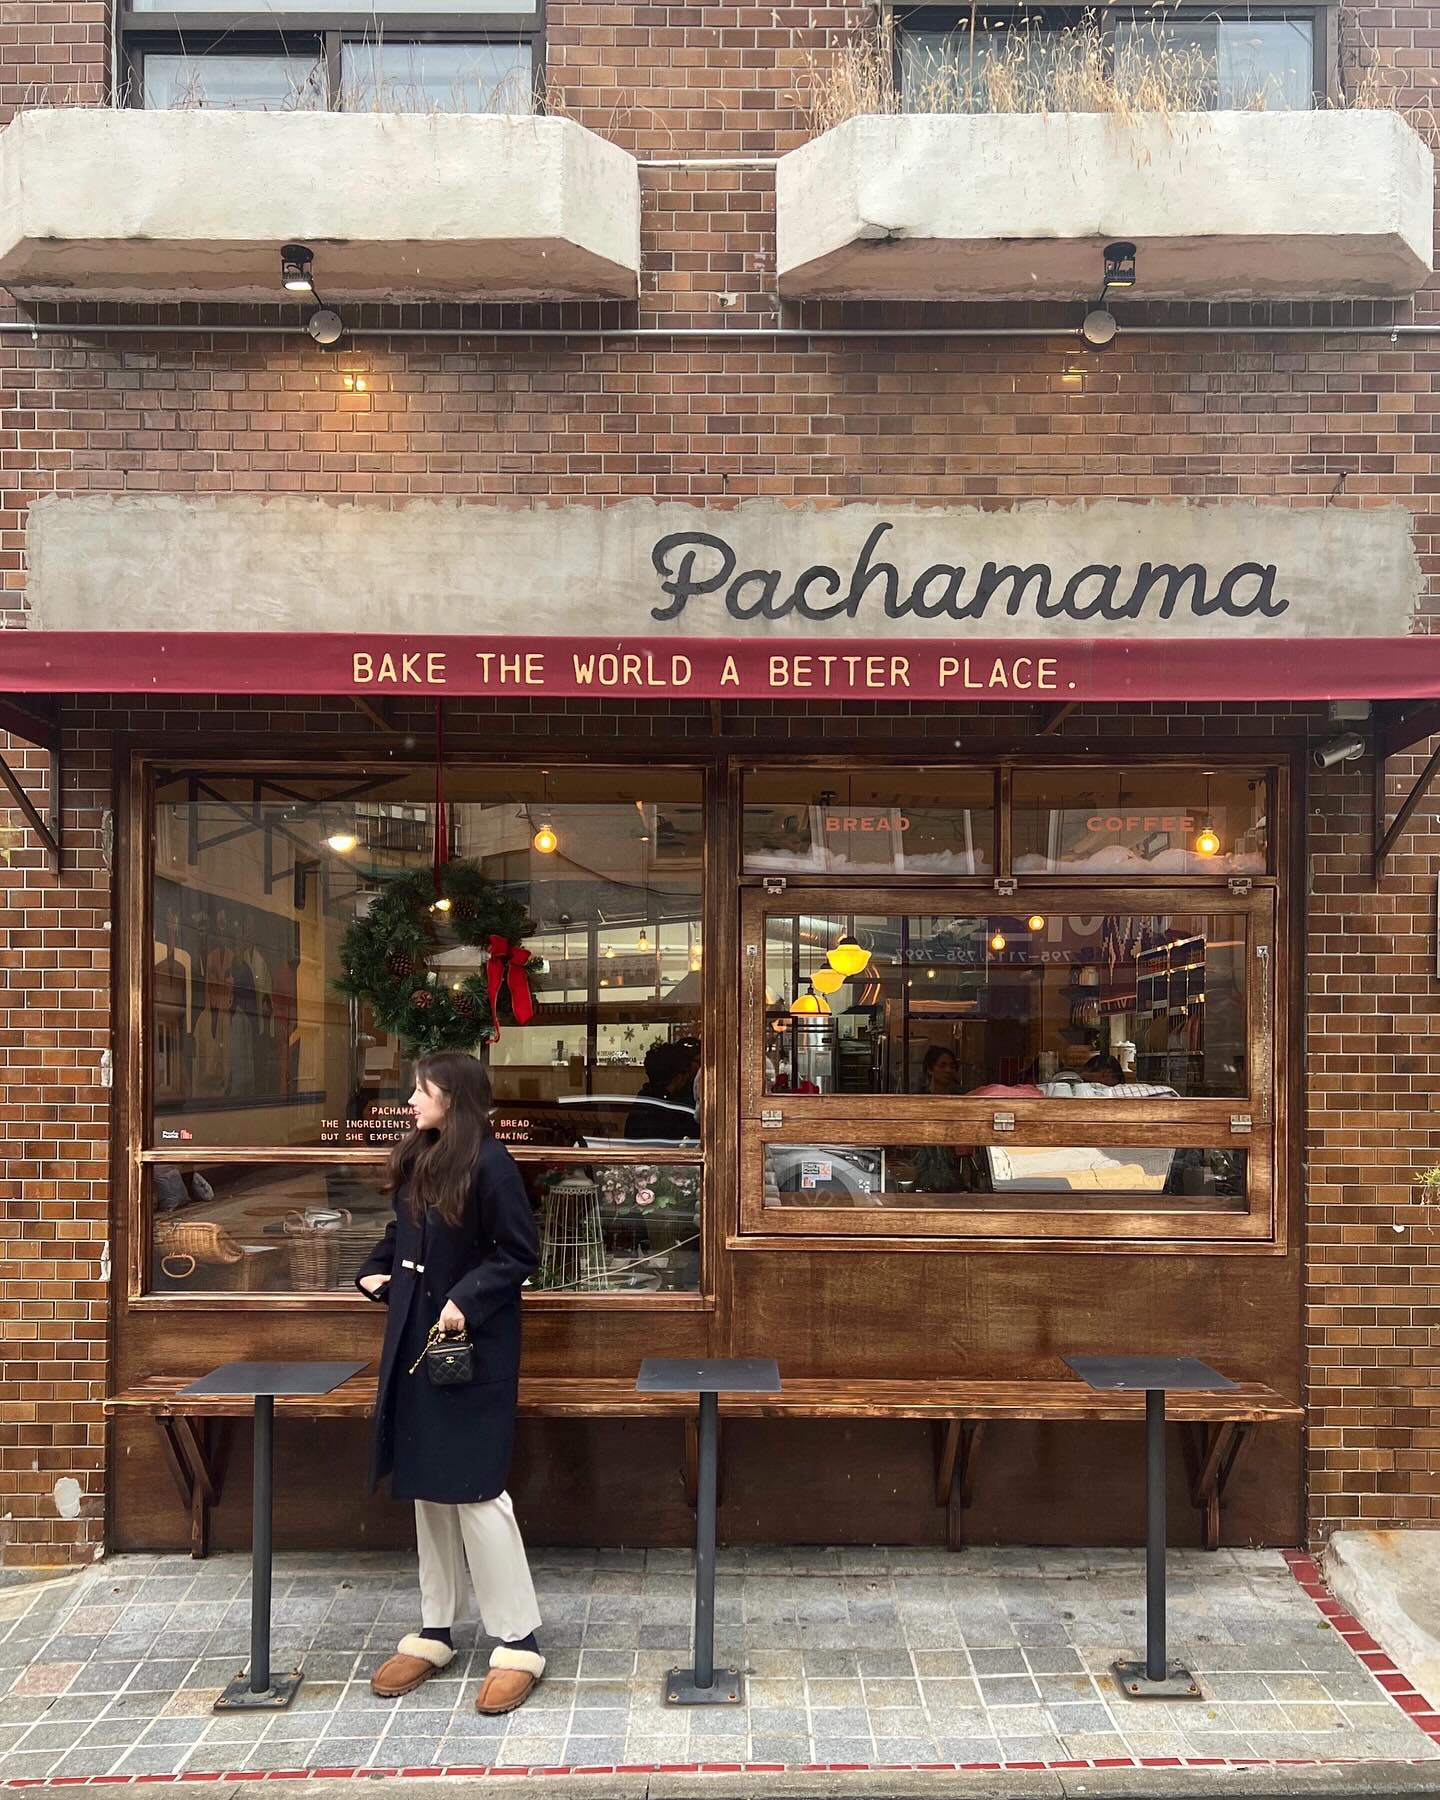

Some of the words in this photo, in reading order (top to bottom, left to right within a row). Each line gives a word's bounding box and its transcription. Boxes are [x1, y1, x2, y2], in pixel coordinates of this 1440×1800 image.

[650, 522, 1290, 620] Pachamama
[352, 652, 447, 684] BAKE
[475, 652, 545, 684] THE
[572, 653, 693, 686] WORLD
[719, 655, 740, 687] A
[769, 655, 911, 688] BETTER
[939, 657, 1077, 689] PLACE.
[825, 816, 911, 832] BREAD
[1086, 816, 1195, 832] COFFEE
[371, 1106, 414, 1115] PACHAMA
[321, 1119, 339, 1128] THE
[346, 1119, 411, 1129] INGREDIENTS
[500, 1119, 534, 1128] BREAD.
[321, 1132, 339, 1141] BUT
[345, 1132, 364, 1141] SHE
[370, 1133, 409, 1141] EXPECT
[494, 1132, 533, 1140] BAKING.
